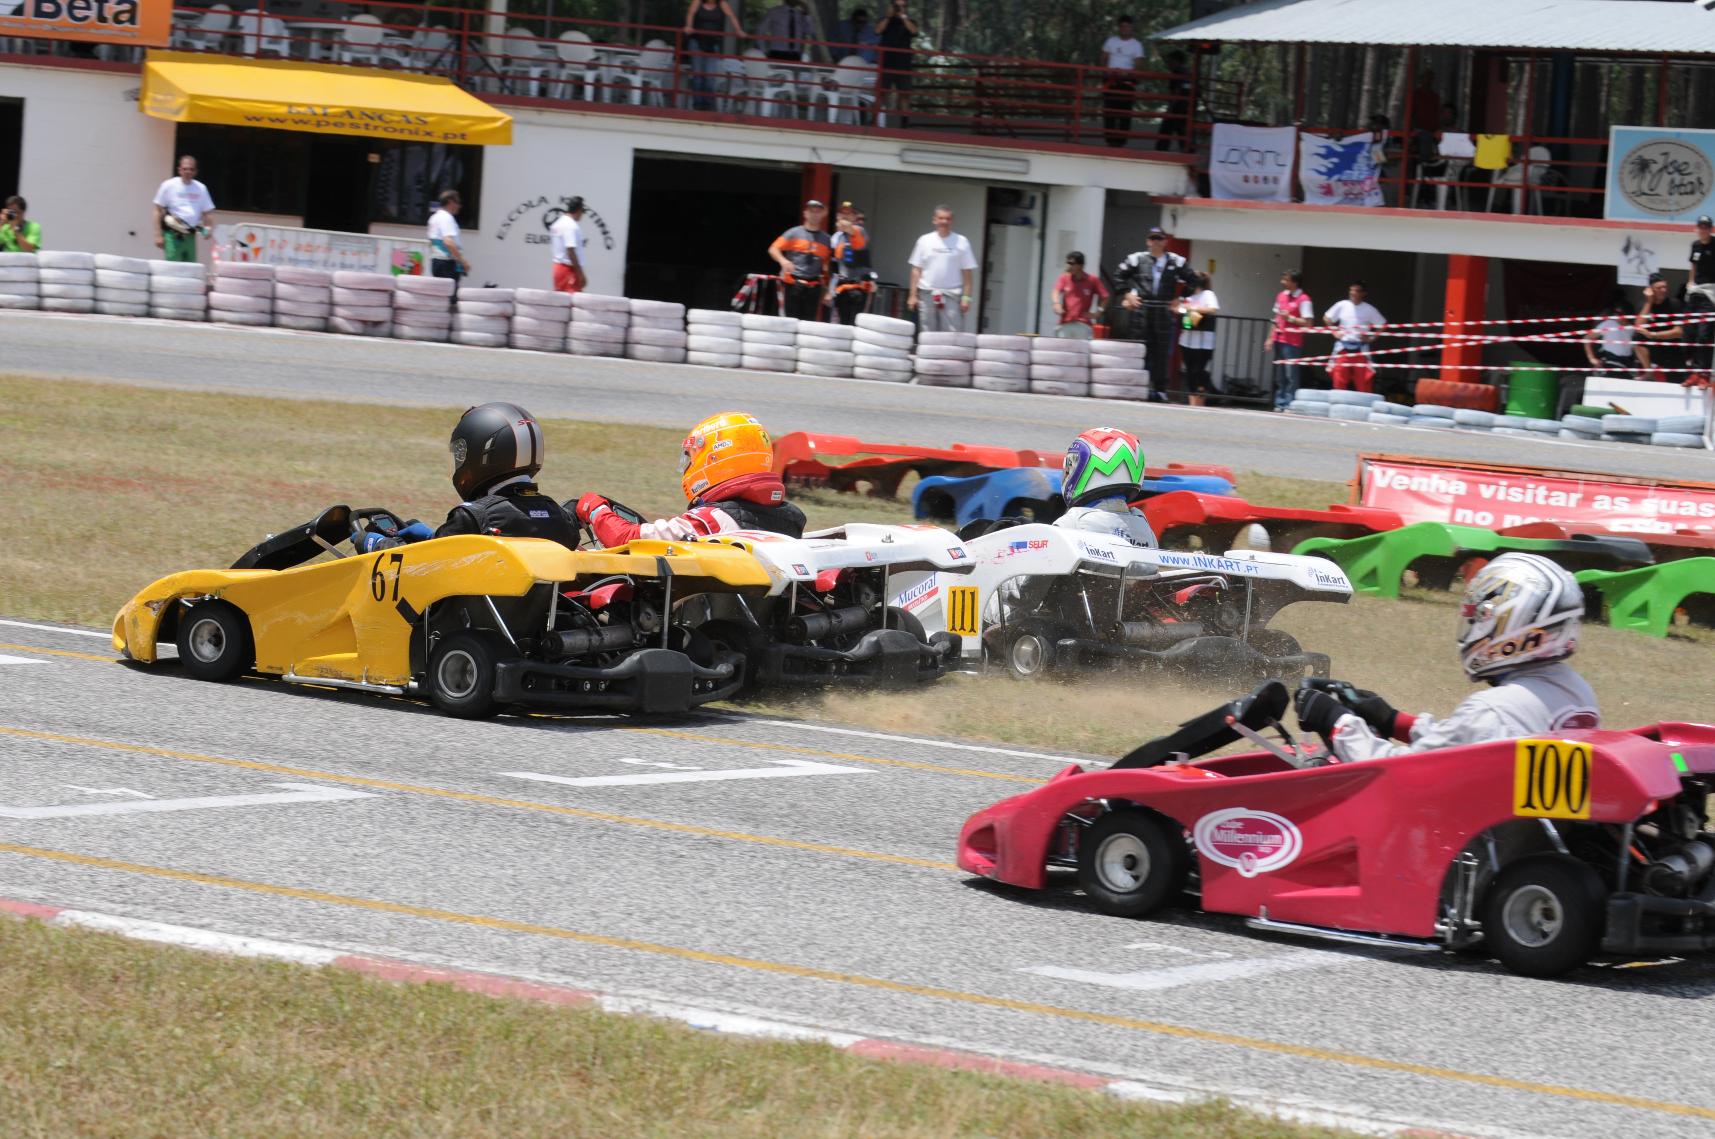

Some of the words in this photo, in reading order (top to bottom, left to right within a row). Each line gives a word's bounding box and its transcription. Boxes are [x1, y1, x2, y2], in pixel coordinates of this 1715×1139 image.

[32, 0, 139, 26] Beta
[243, 114, 468, 141] www.pestronix.pt
[559, 195, 616, 250] KTING
[1373, 468, 1467, 496] Venha
[1479, 481, 1583, 508] visitar
[1592, 494, 1631, 512] as
[1640, 498, 1715, 518] suas
[1455, 508, 1494, 526] no
[1028, 540, 1049, 549] SEUR
[371, 552, 404, 602] 67
[1158, 554, 1260, 574] www.INKART.PT
[899, 571, 935, 606] Mucoral
[1520, 744, 1589, 814] 100
